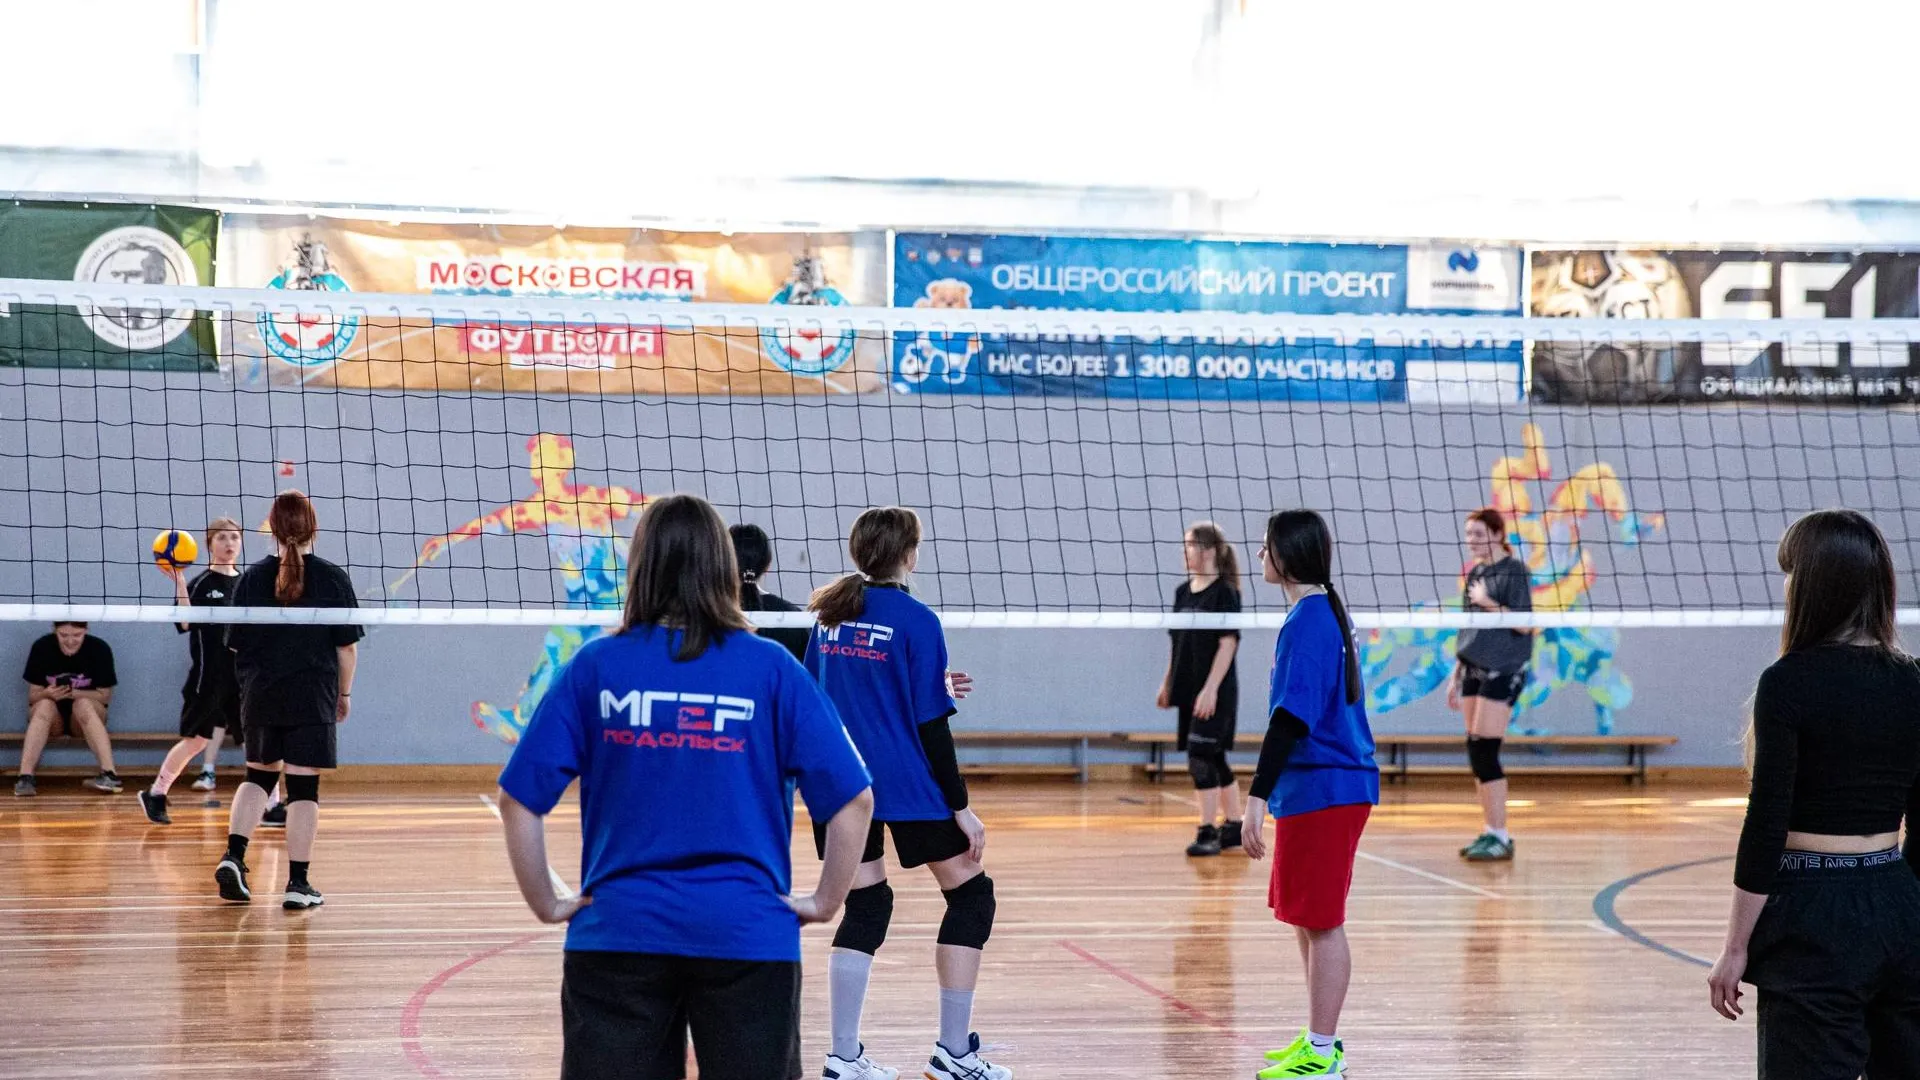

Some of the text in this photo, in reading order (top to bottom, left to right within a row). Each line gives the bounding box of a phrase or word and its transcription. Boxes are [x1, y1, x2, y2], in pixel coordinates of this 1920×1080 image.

[429, 261, 694, 291] МОСКОВСКАЯ
[991, 263, 1397, 299] ОБЩЕРОССИЙСКИЙ ПРОЕКТ
[1700, 261, 1920, 367] SEL
[470, 325, 656, 354] ФУТБОЛА
[987, 352, 1396, 381] НАС БОЛЕЕ 1 308 000 УЧАСТНИКОВ
[603, 729, 746, 753] ПОДОЛЬСК
